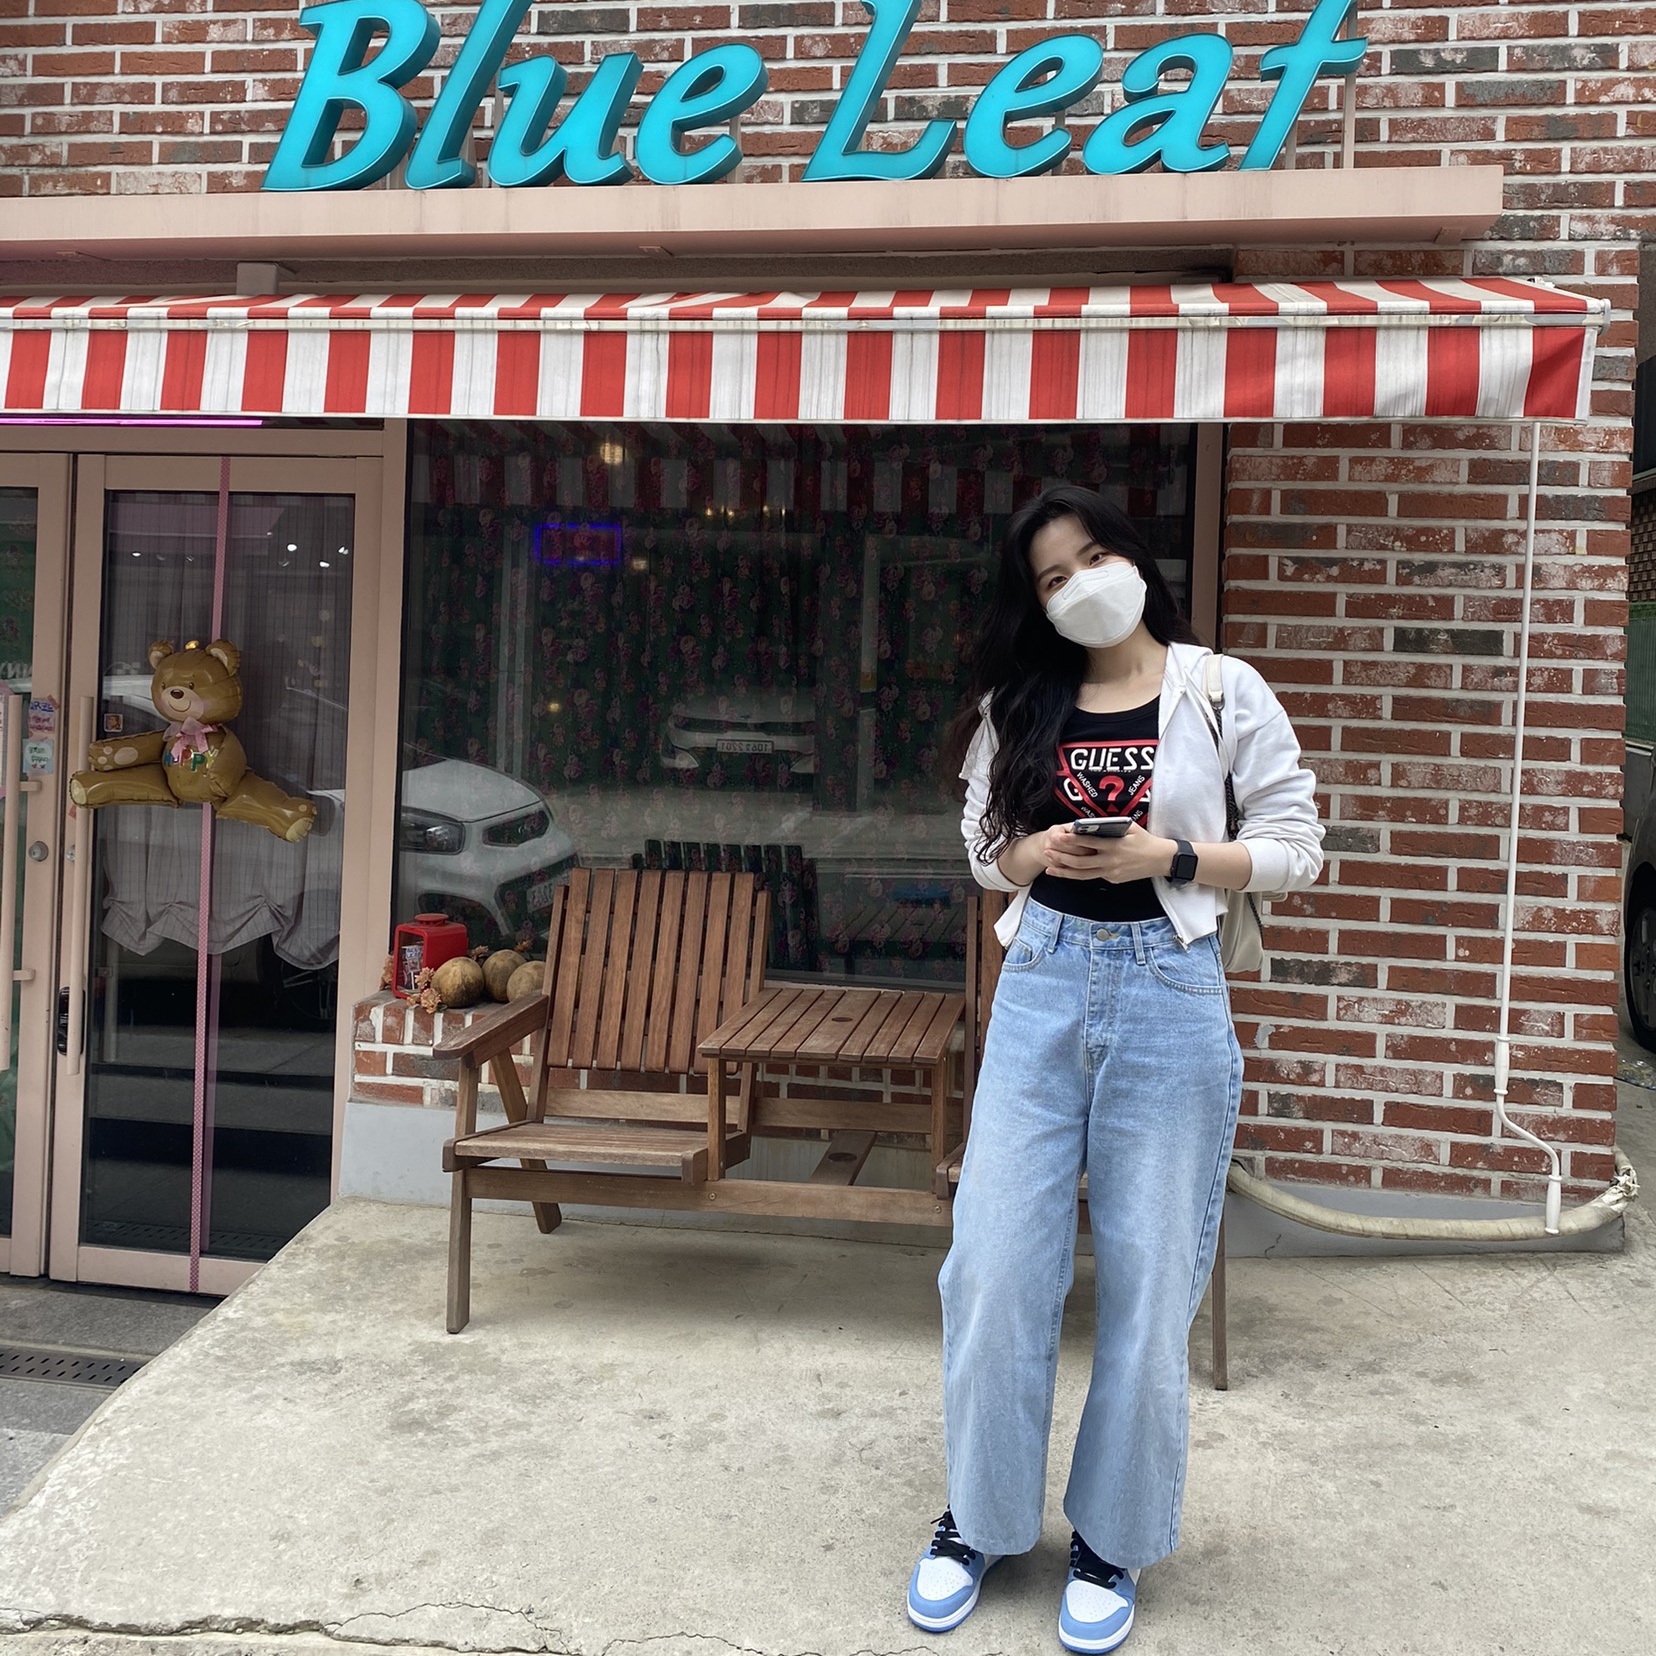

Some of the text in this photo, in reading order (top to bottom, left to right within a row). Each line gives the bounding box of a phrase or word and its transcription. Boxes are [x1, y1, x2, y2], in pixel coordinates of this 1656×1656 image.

[261, 0, 1369, 191] Blue Leaf
[1070, 747, 1155, 771] GUESS
[1077, 772, 1098, 797] WASHED
[1128, 775, 1145, 796] JEANS
